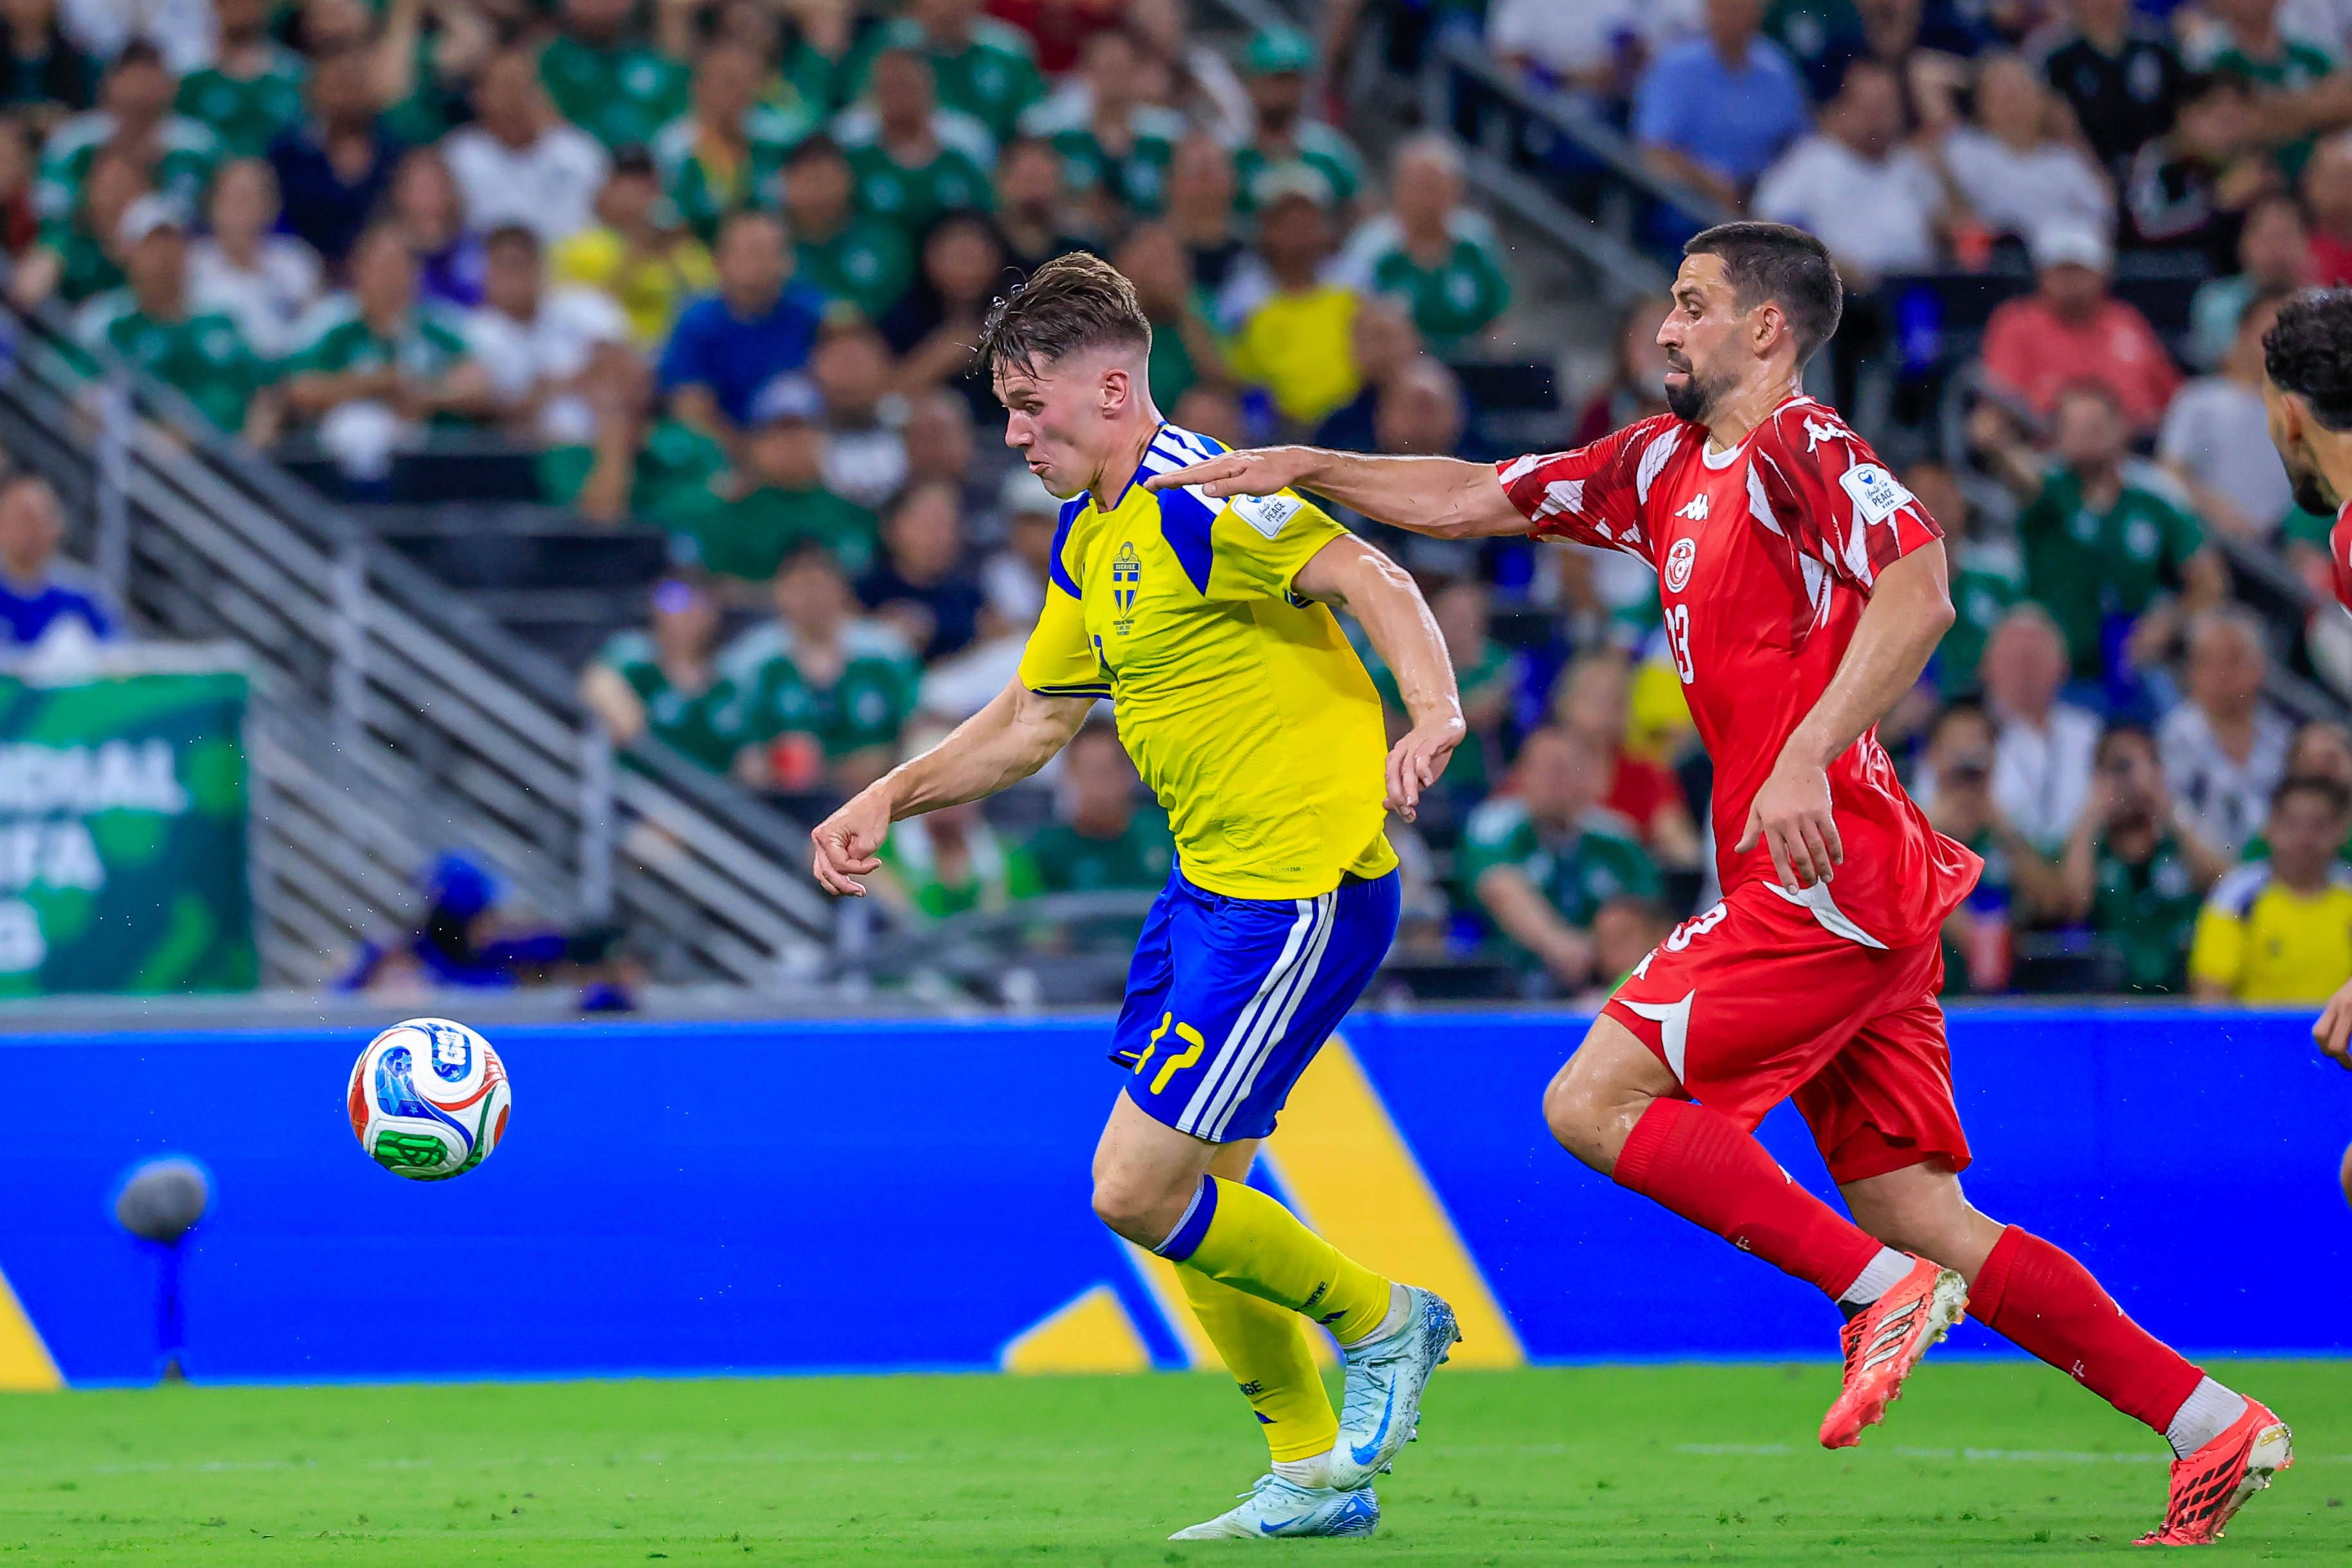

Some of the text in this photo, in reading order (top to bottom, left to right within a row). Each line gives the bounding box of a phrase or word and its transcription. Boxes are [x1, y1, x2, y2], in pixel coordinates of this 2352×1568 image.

[1872, 488, 1895, 507] PEACE
[1882, 499, 1895, 509] FIFA
[1264, 501, 1286, 522] PEACE
[1276, 511, 1287, 522] FIFA
[1665, 604, 1694, 685] 13
[1134, 1011, 1205, 1095] 17
